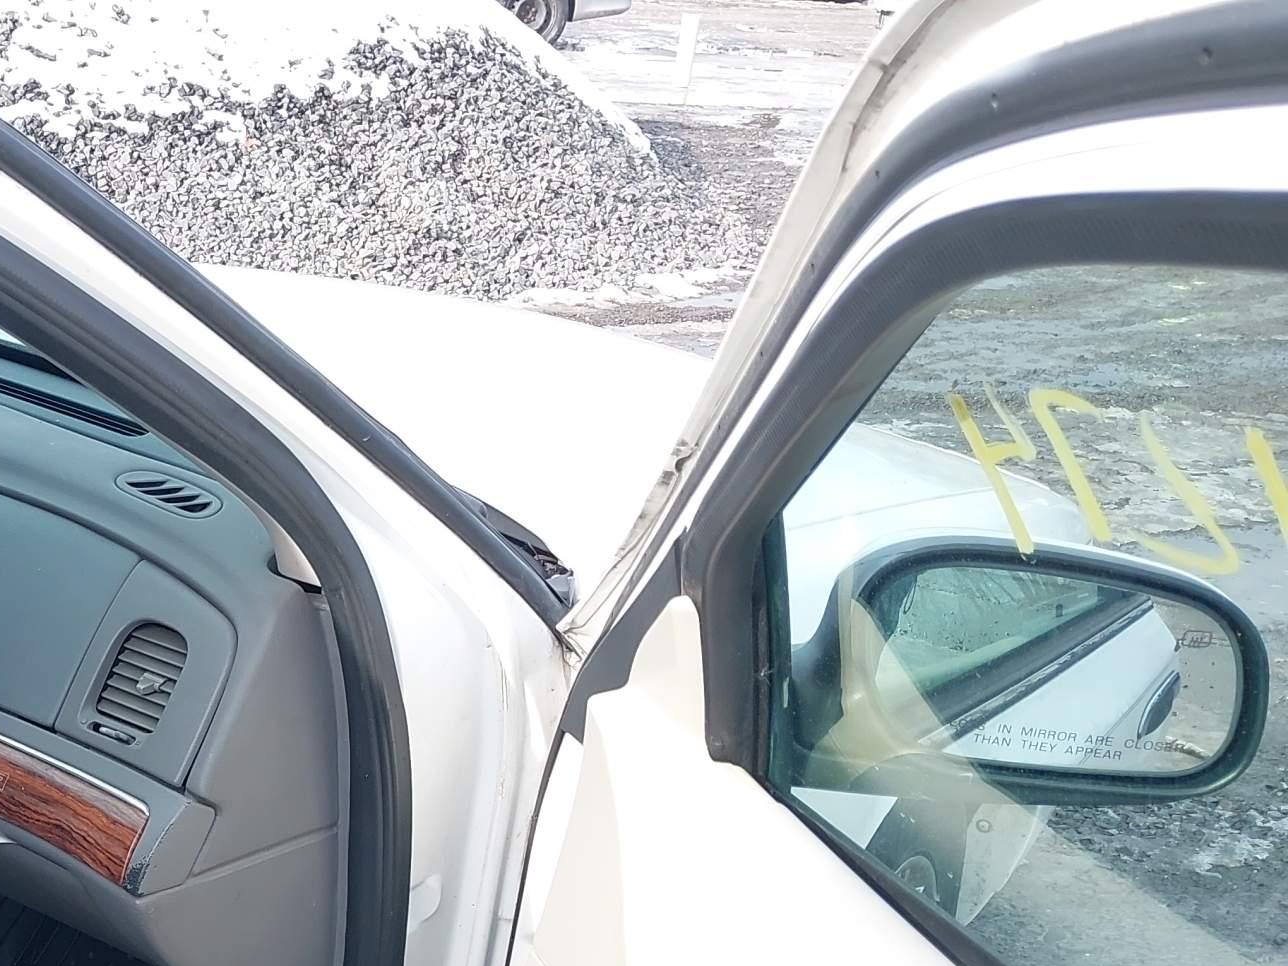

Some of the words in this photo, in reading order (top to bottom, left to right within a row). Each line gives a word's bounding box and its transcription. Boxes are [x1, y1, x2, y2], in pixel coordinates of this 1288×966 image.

[974, 733, 1011, 747] THAN
[1021, 739, 1057, 753] THEY
[1064, 745, 1123, 761] APPEAR
[997, 723, 1012, 734] IN
[1020, 726, 1078, 742] MIRROR
[1084, 734, 1115, 747] ARE
